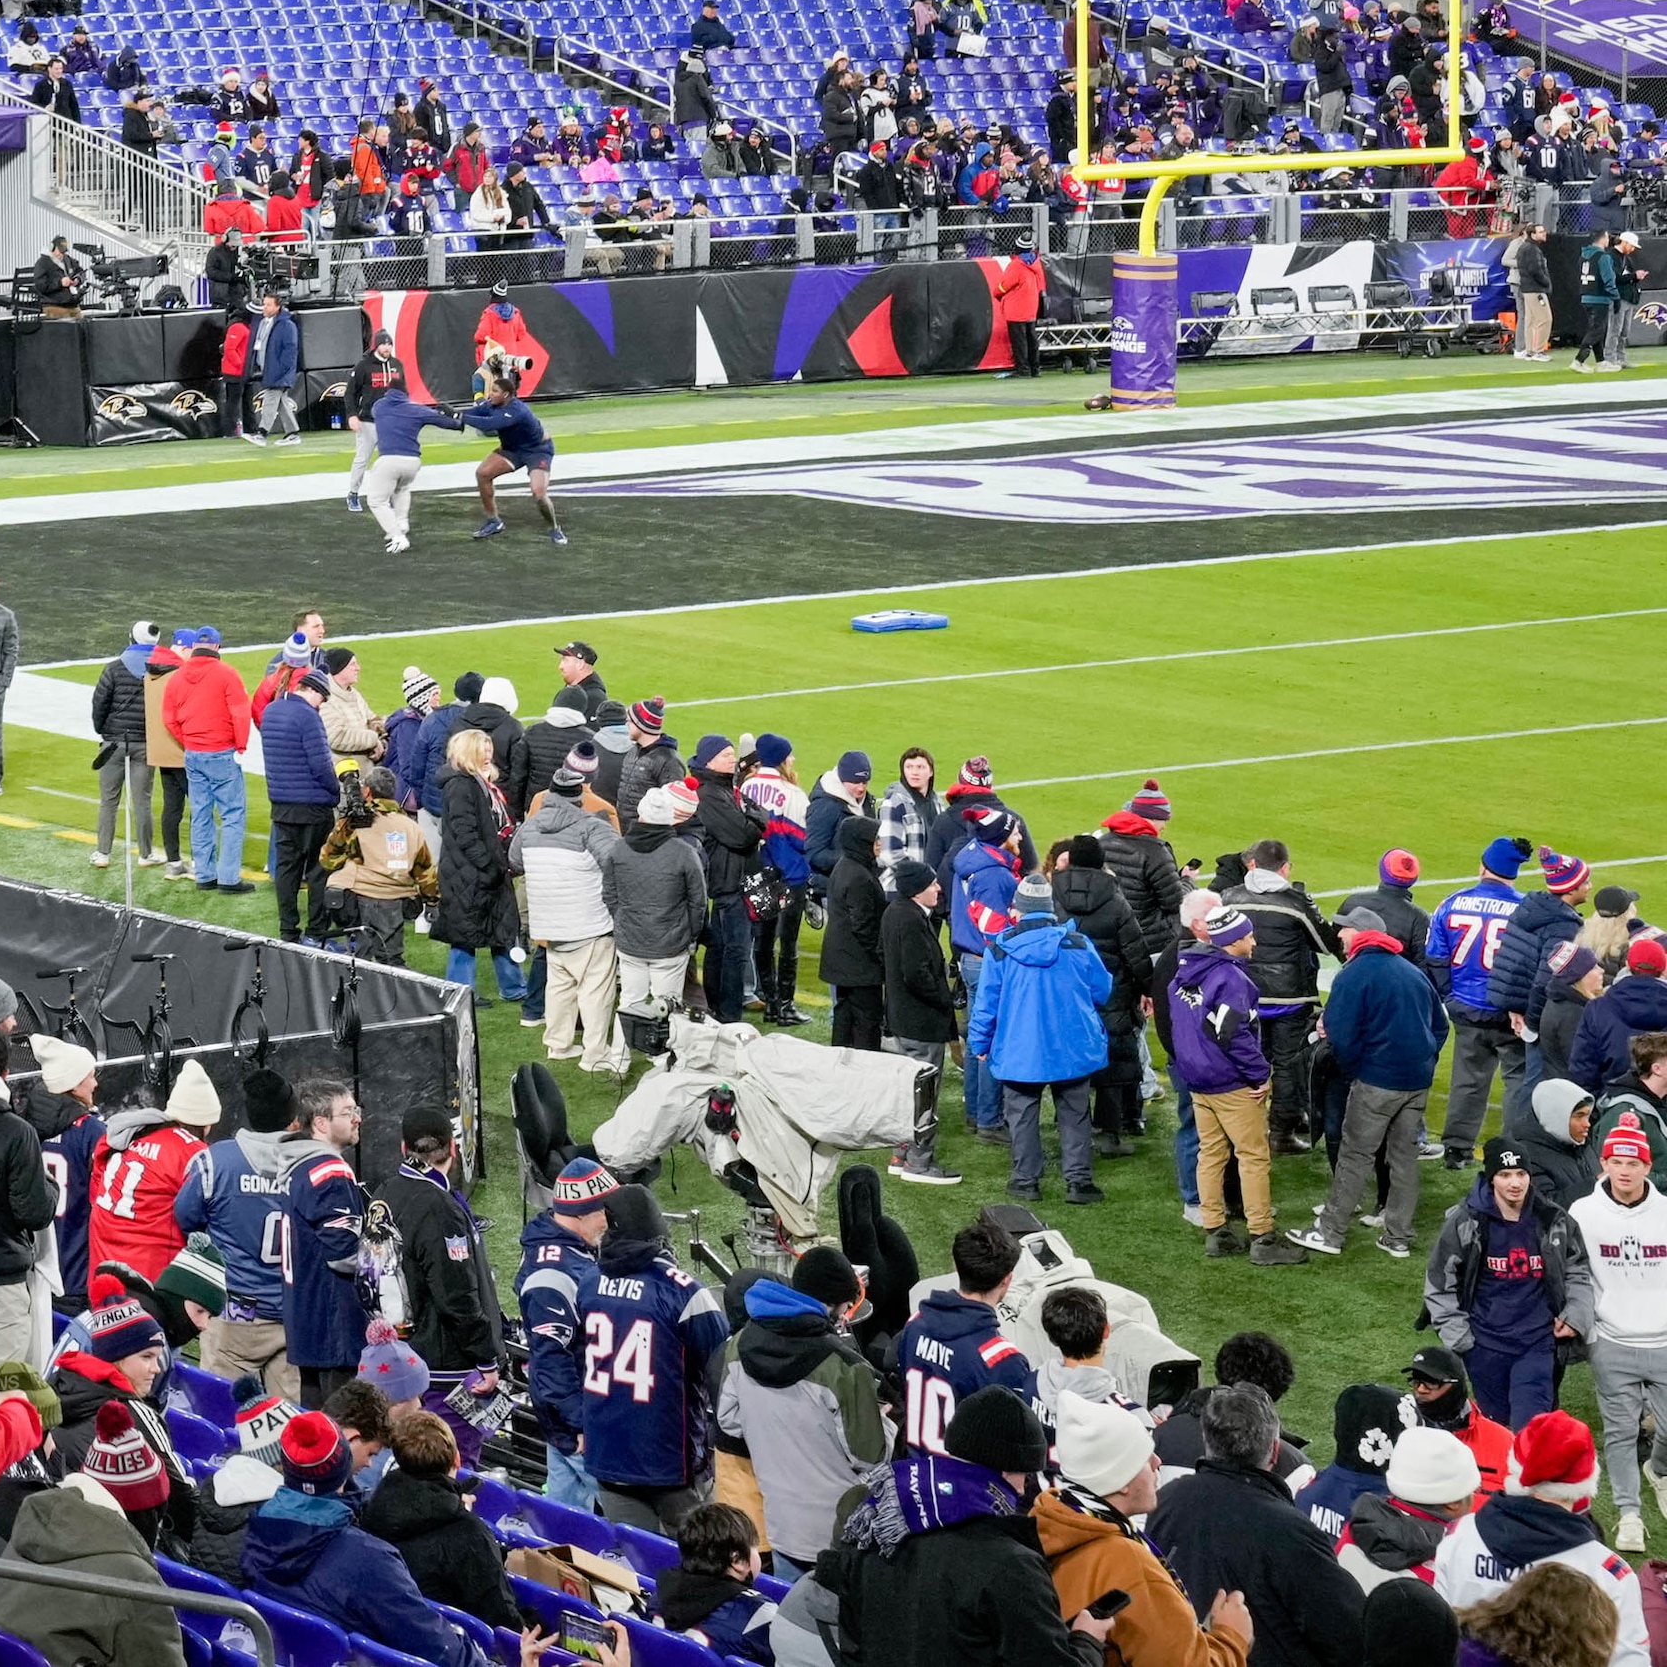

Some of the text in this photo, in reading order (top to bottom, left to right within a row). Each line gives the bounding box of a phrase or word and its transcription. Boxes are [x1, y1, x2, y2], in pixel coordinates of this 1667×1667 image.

[1540, 148, 1556, 168] 10
[406, 211, 424, 233] 10
[1459, 269, 1489, 287] NIGHT
[96, 1154, 145, 1222] 11
[536, 1244, 562, 1265] 12
[597, 1275, 645, 1302] REVIS
[583, 1311, 655, 1404] 24
[916, 1336, 953, 1370] MAYE
[905, 1367, 957, 1455] 10
[1309, 1504, 1345, 1539] MAYE
